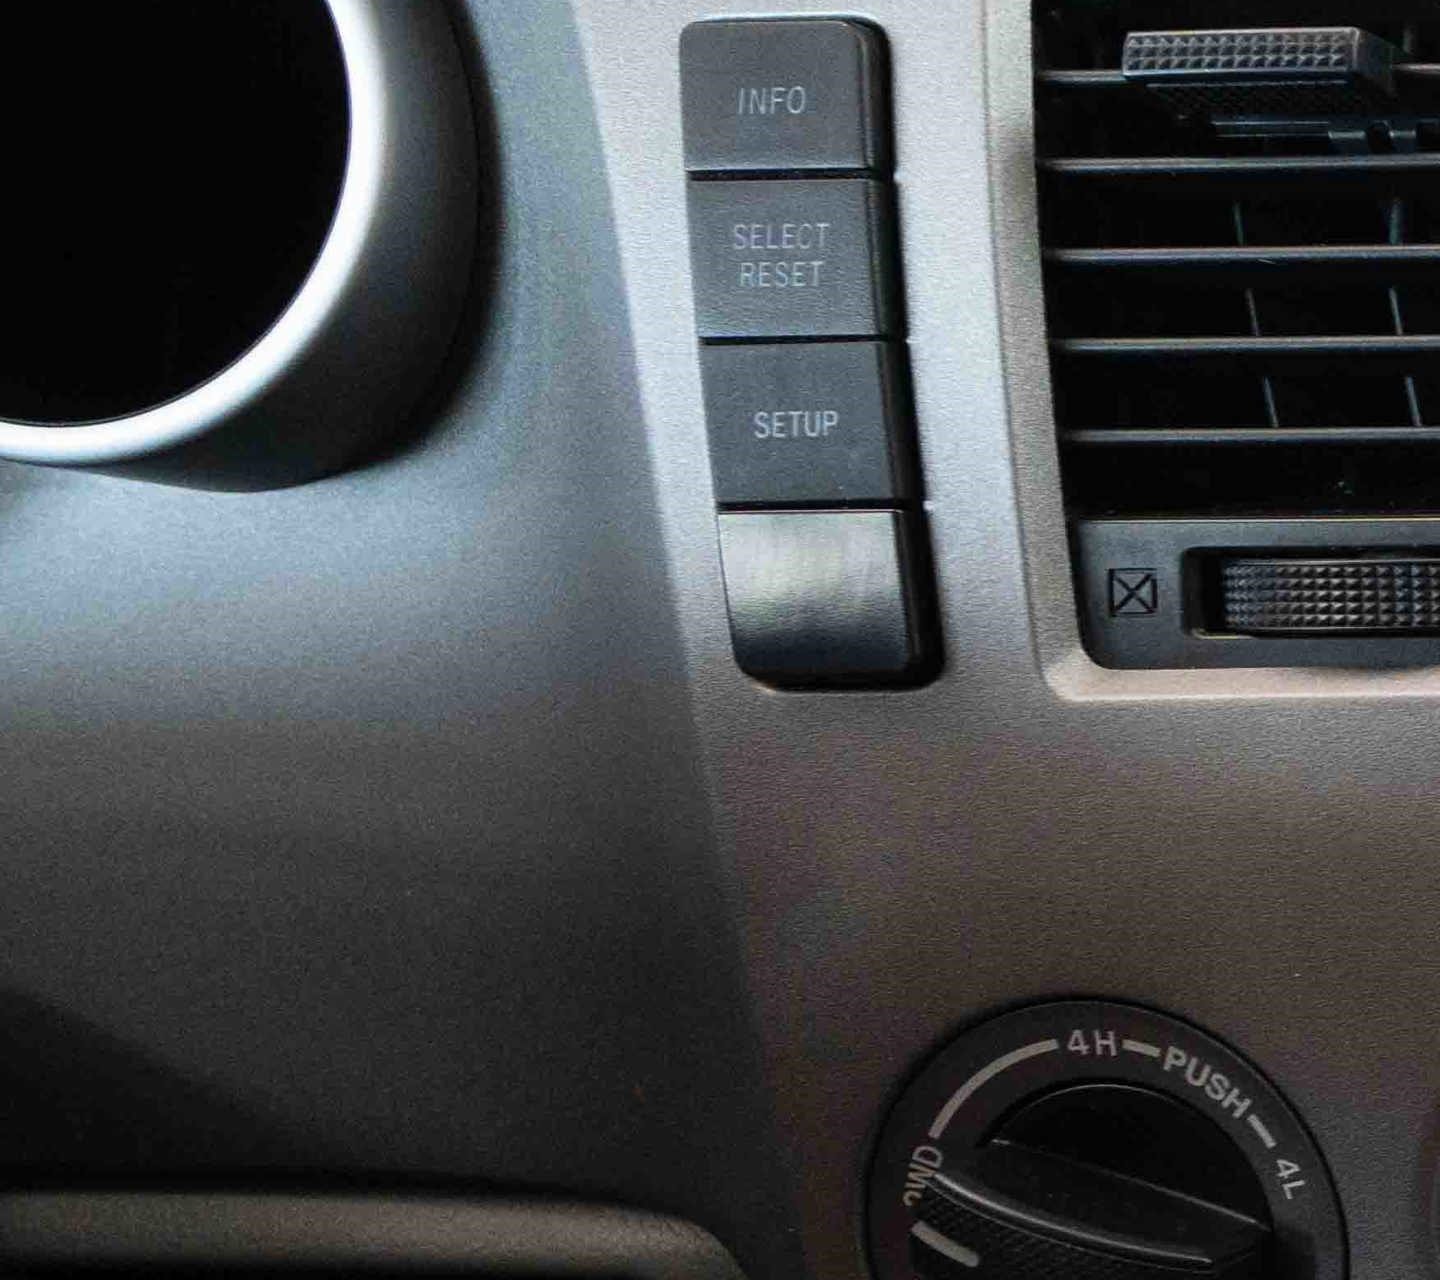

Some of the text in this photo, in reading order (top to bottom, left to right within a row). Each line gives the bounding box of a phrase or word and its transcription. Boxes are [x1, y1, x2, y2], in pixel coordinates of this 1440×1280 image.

[737, 85, 806, 115] INFO
[732, 222, 831, 250] SELECT
[740, 260, 825, 289] RESET
[753, 410, 839, 439] SETUP
[1066, 1029, 1118, 1058] 4H
[1161, 1045, 1253, 1120] PUSH
[1276, 1158, 1307, 1200] 4L
